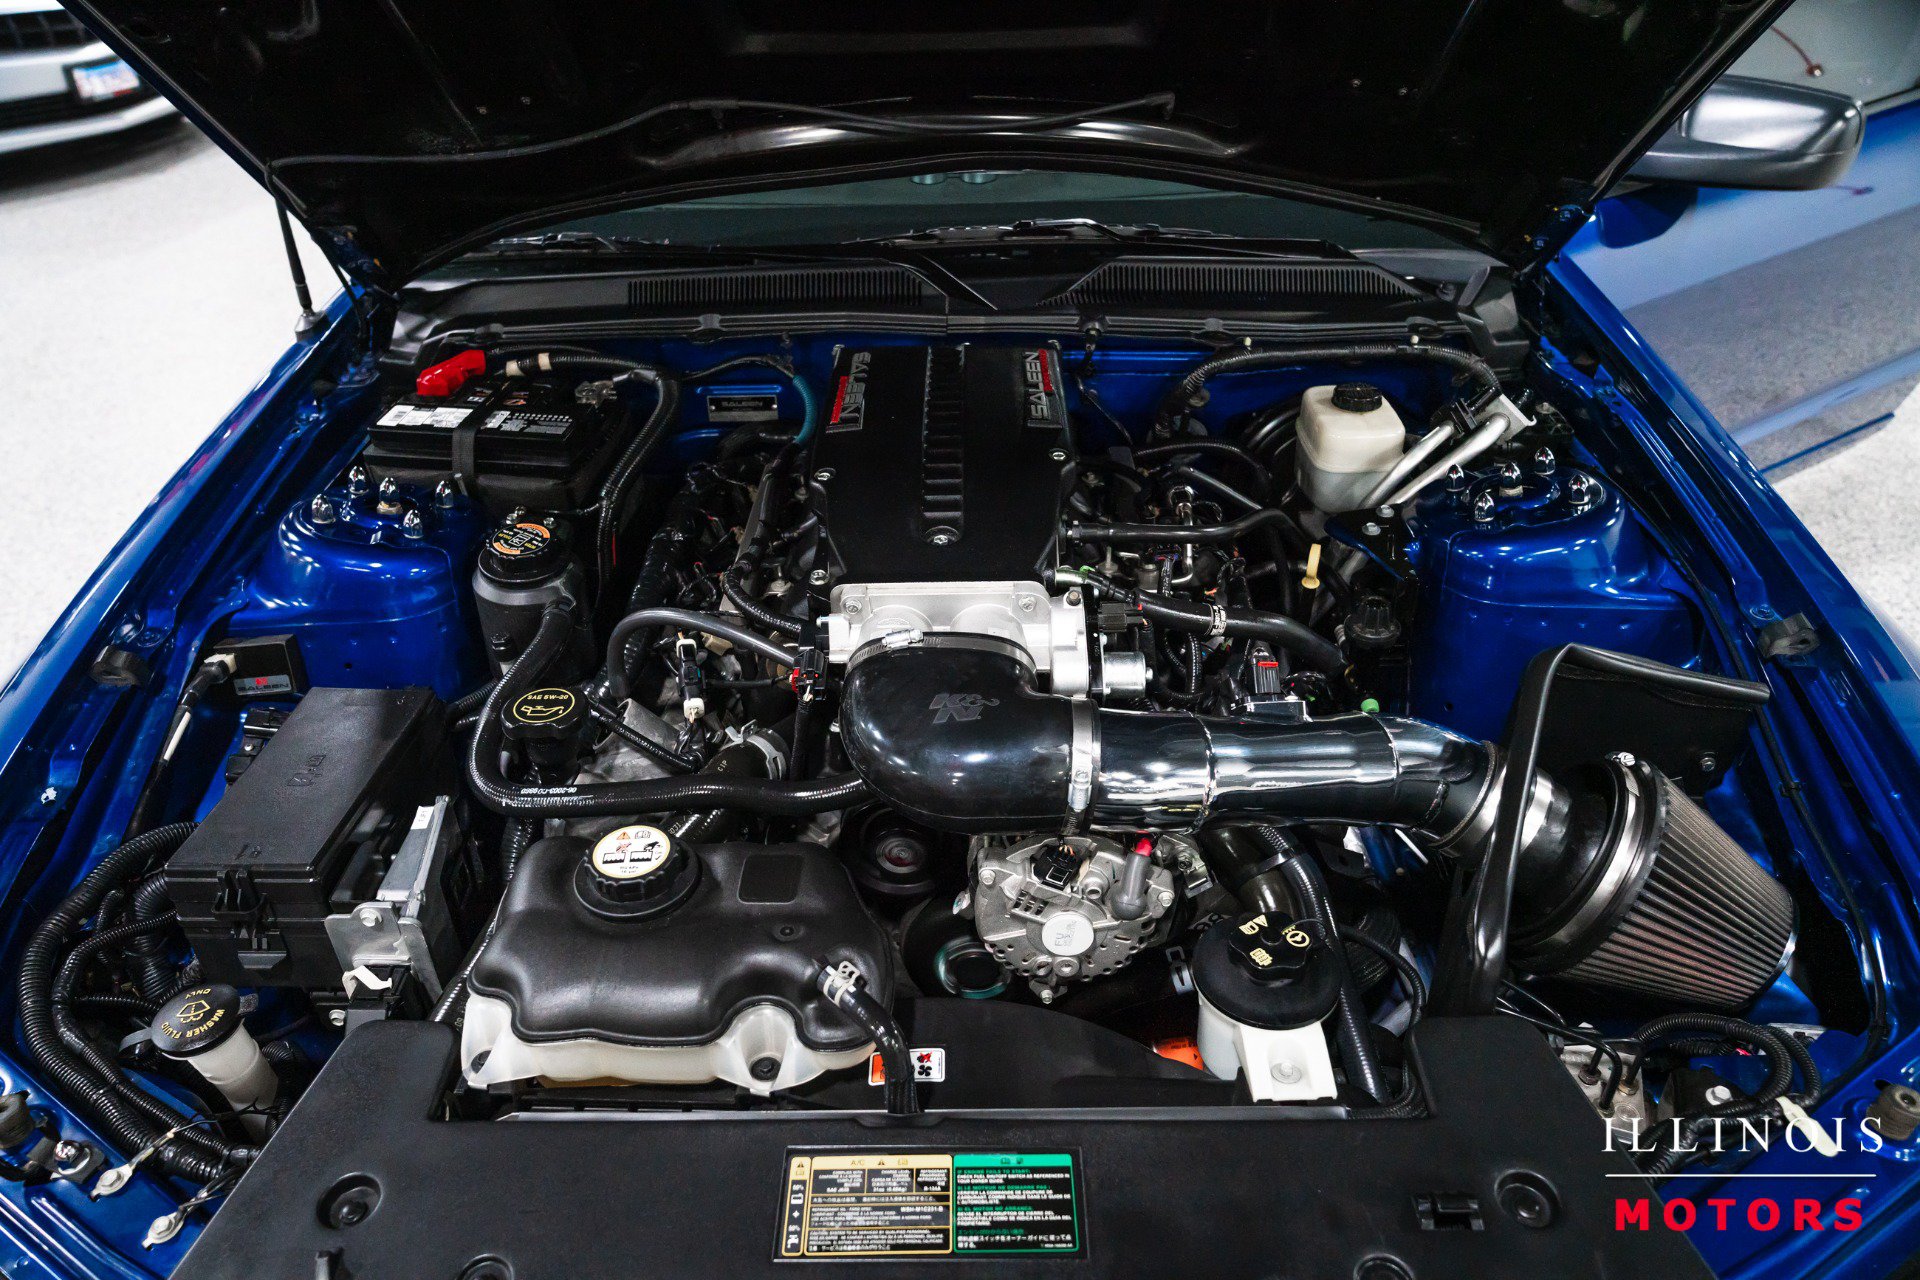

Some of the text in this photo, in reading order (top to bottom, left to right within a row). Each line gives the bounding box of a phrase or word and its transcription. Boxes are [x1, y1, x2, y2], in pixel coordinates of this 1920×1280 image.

[840, 352, 871, 418] SALEEN
[1024, 351, 1048, 419] SALEEN
[238, 683, 289, 692] SALEEN
[185, 988, 211, 1000] ONLY
[161, 1009, 226, 1039] WASHER FLUID
